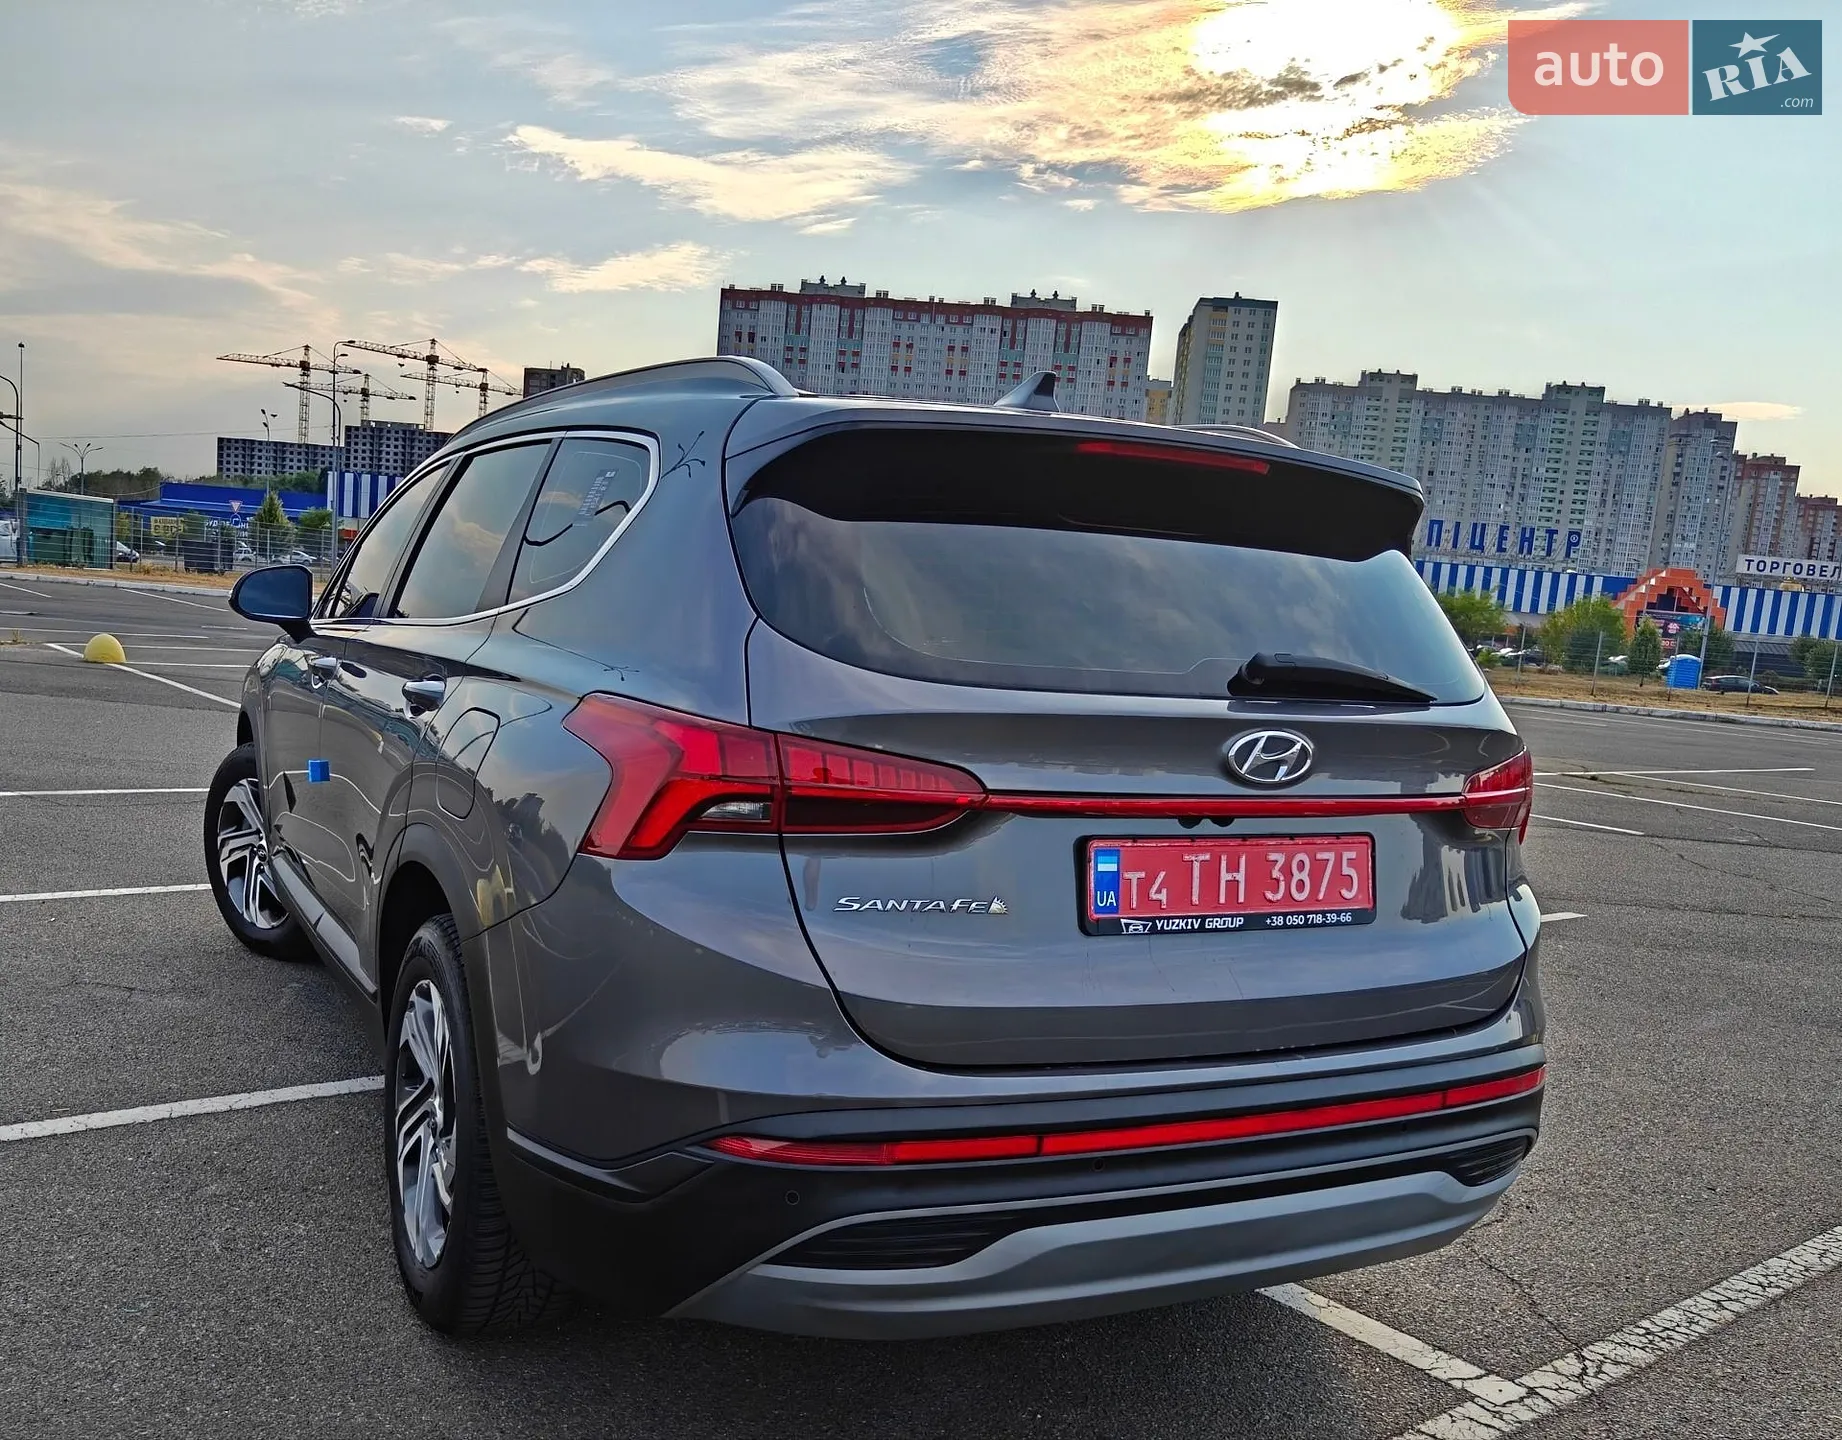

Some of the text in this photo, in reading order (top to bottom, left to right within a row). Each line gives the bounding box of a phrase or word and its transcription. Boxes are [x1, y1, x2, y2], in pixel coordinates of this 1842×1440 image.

[1426, 519, 1582, 559] ПІЦЕНТР
[1122, 851, 1359, 909] T4 TH 3875
[1096, 890, 1117, 907] UA
[1155, 917, 1245, 931] YUZKIV GROUP
[1265, 912, 1353, 926] +38 050 718-39-66
